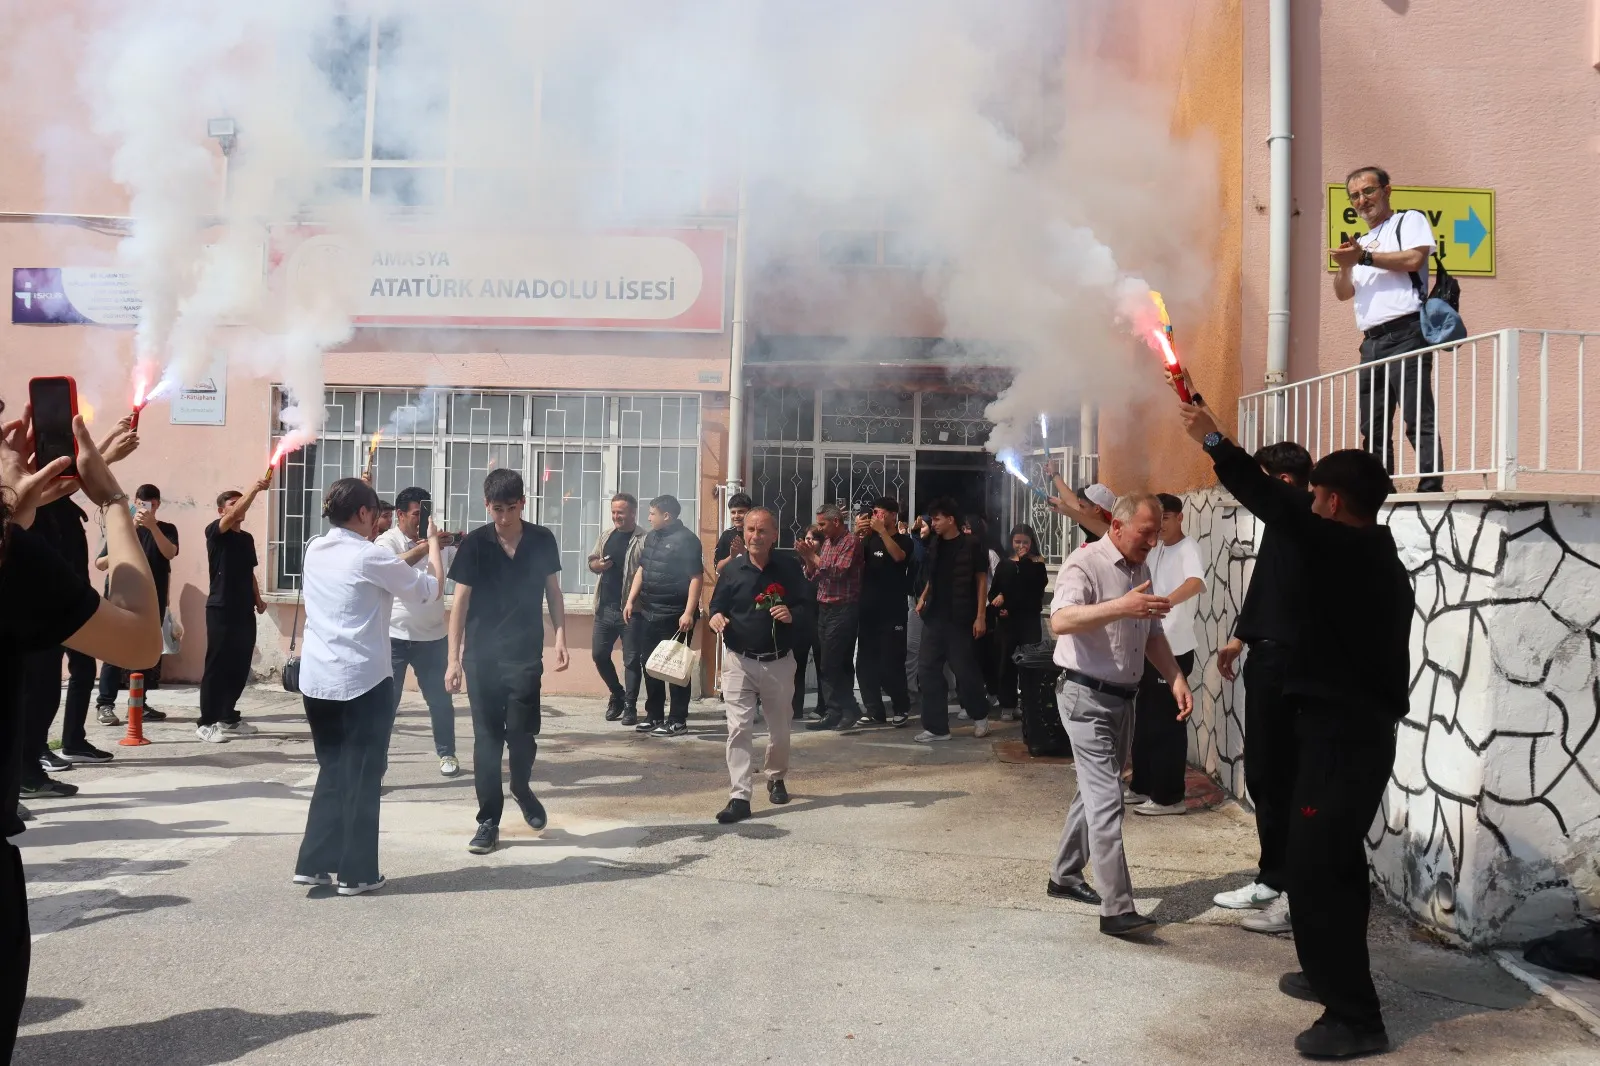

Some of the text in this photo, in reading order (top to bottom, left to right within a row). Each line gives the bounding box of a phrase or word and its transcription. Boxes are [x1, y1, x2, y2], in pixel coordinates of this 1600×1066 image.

[371, 250, 450, 267] AMASYA
[369, 275, 676, 301] ATATÜRK ANADOLU LİSESİ
